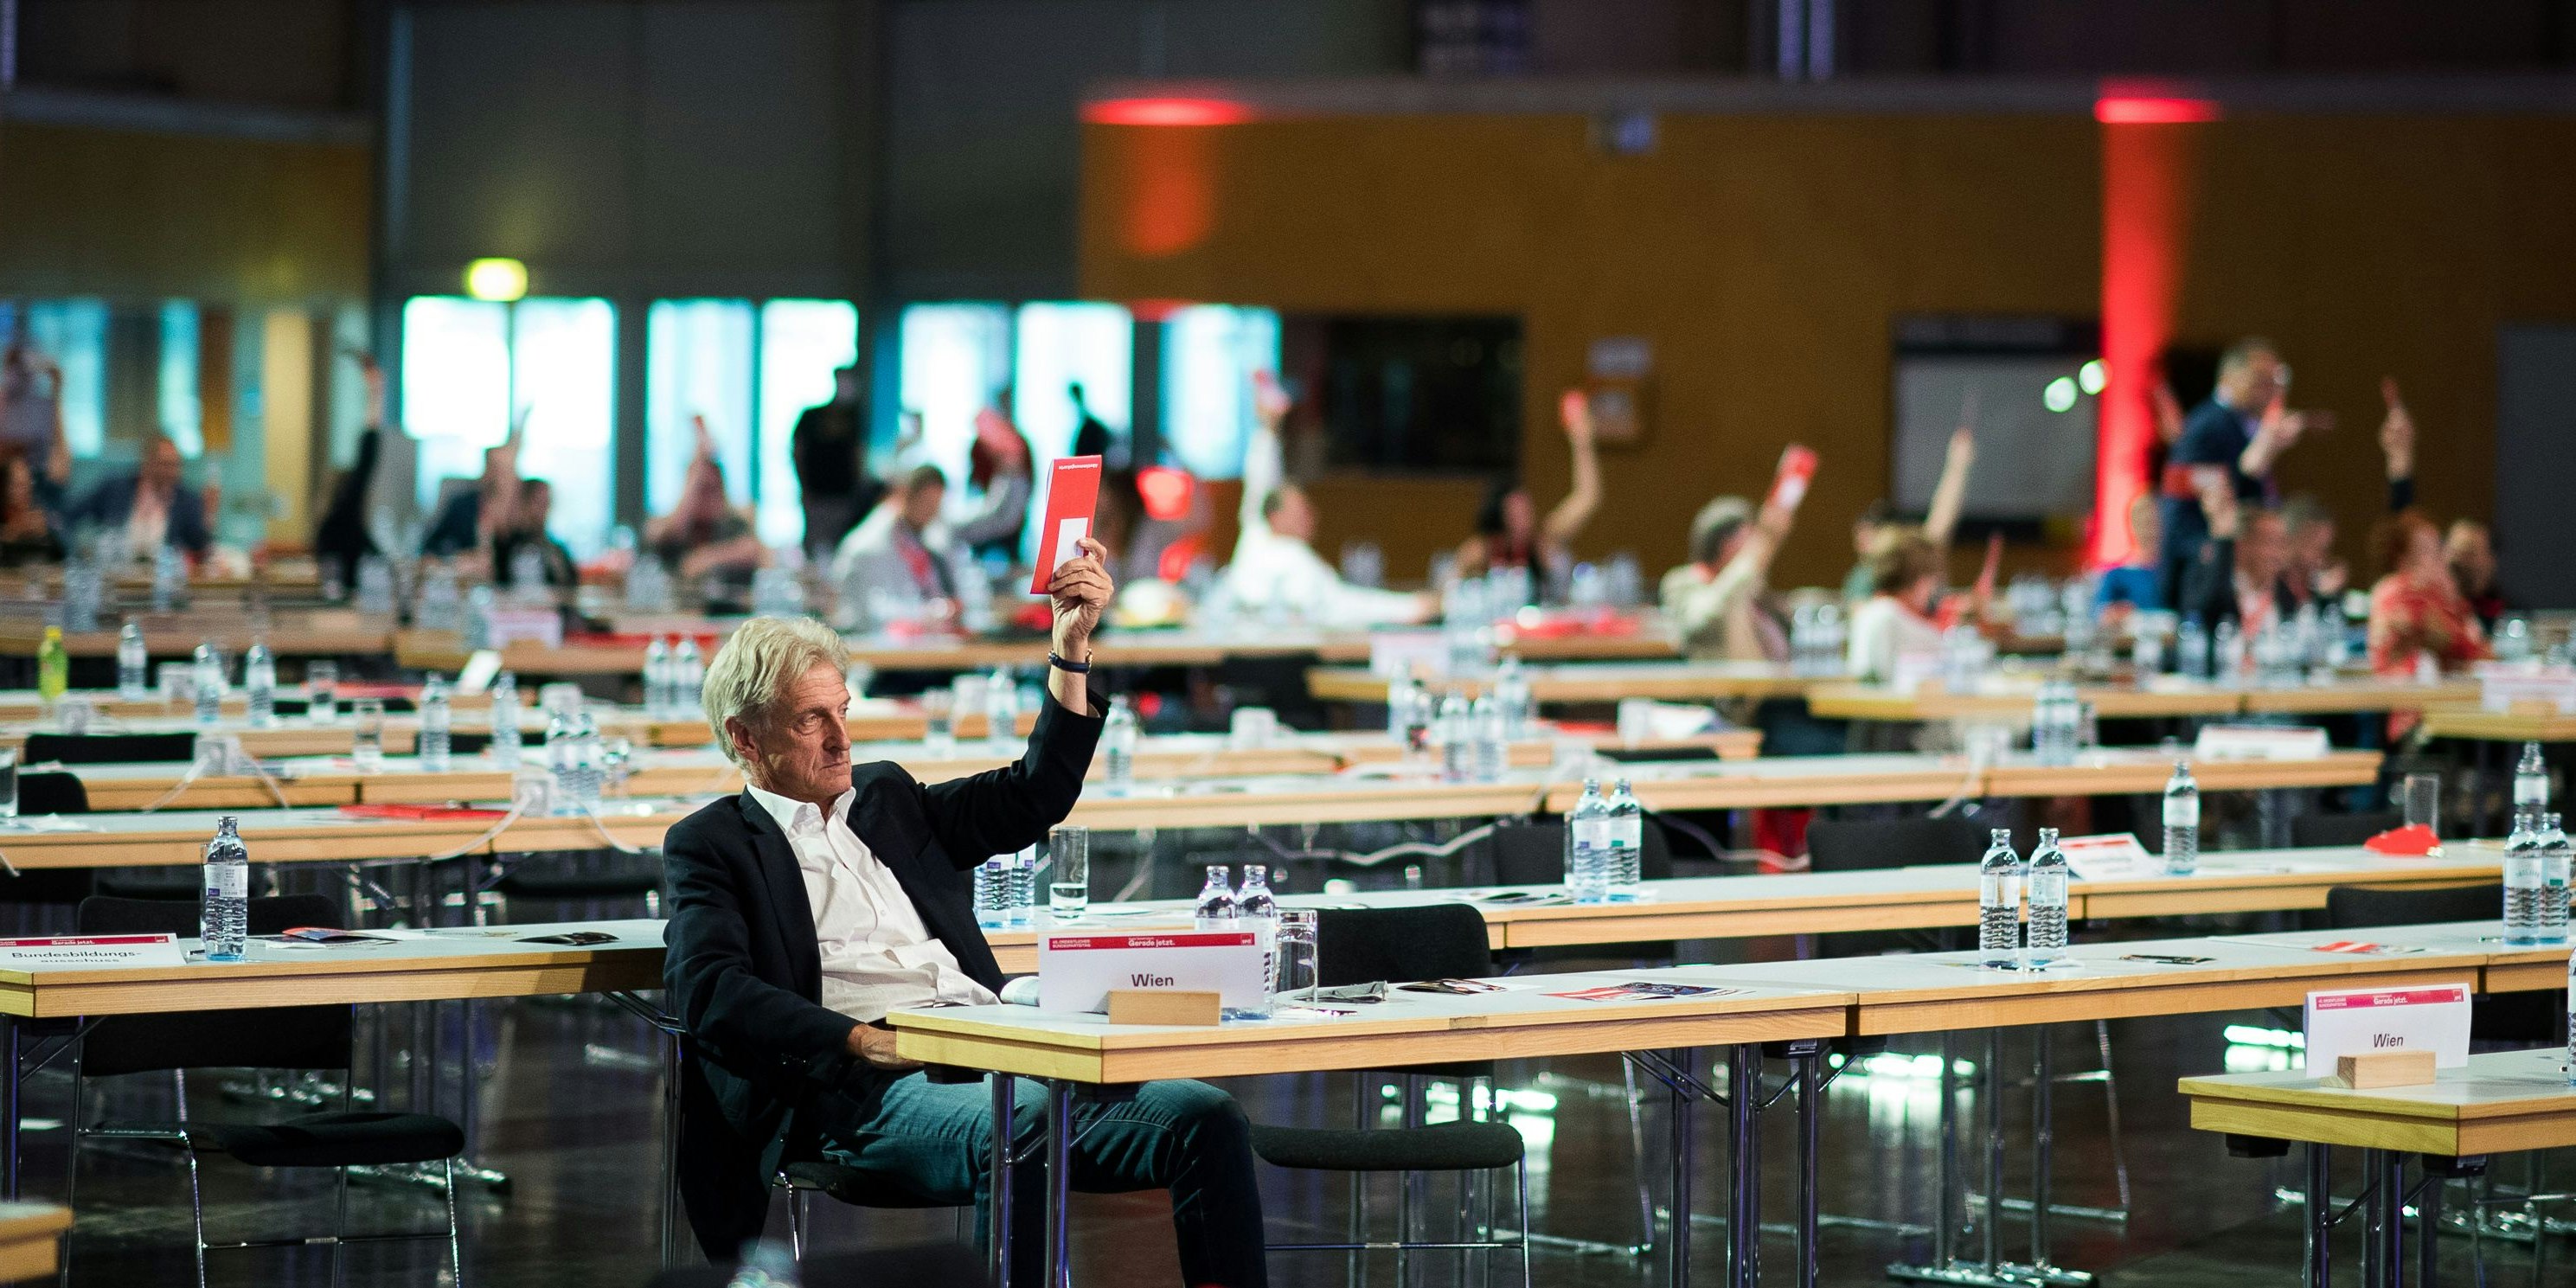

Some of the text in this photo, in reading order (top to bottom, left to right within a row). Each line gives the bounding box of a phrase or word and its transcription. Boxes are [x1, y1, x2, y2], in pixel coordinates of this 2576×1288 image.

[1156, 939, 1176, 947] jetzt.
[1131, 973, 1175, 987] Wien
[2373, 996, 2393, 1005] Gerade
[2374, 1033, 2404, 1048] Wien
